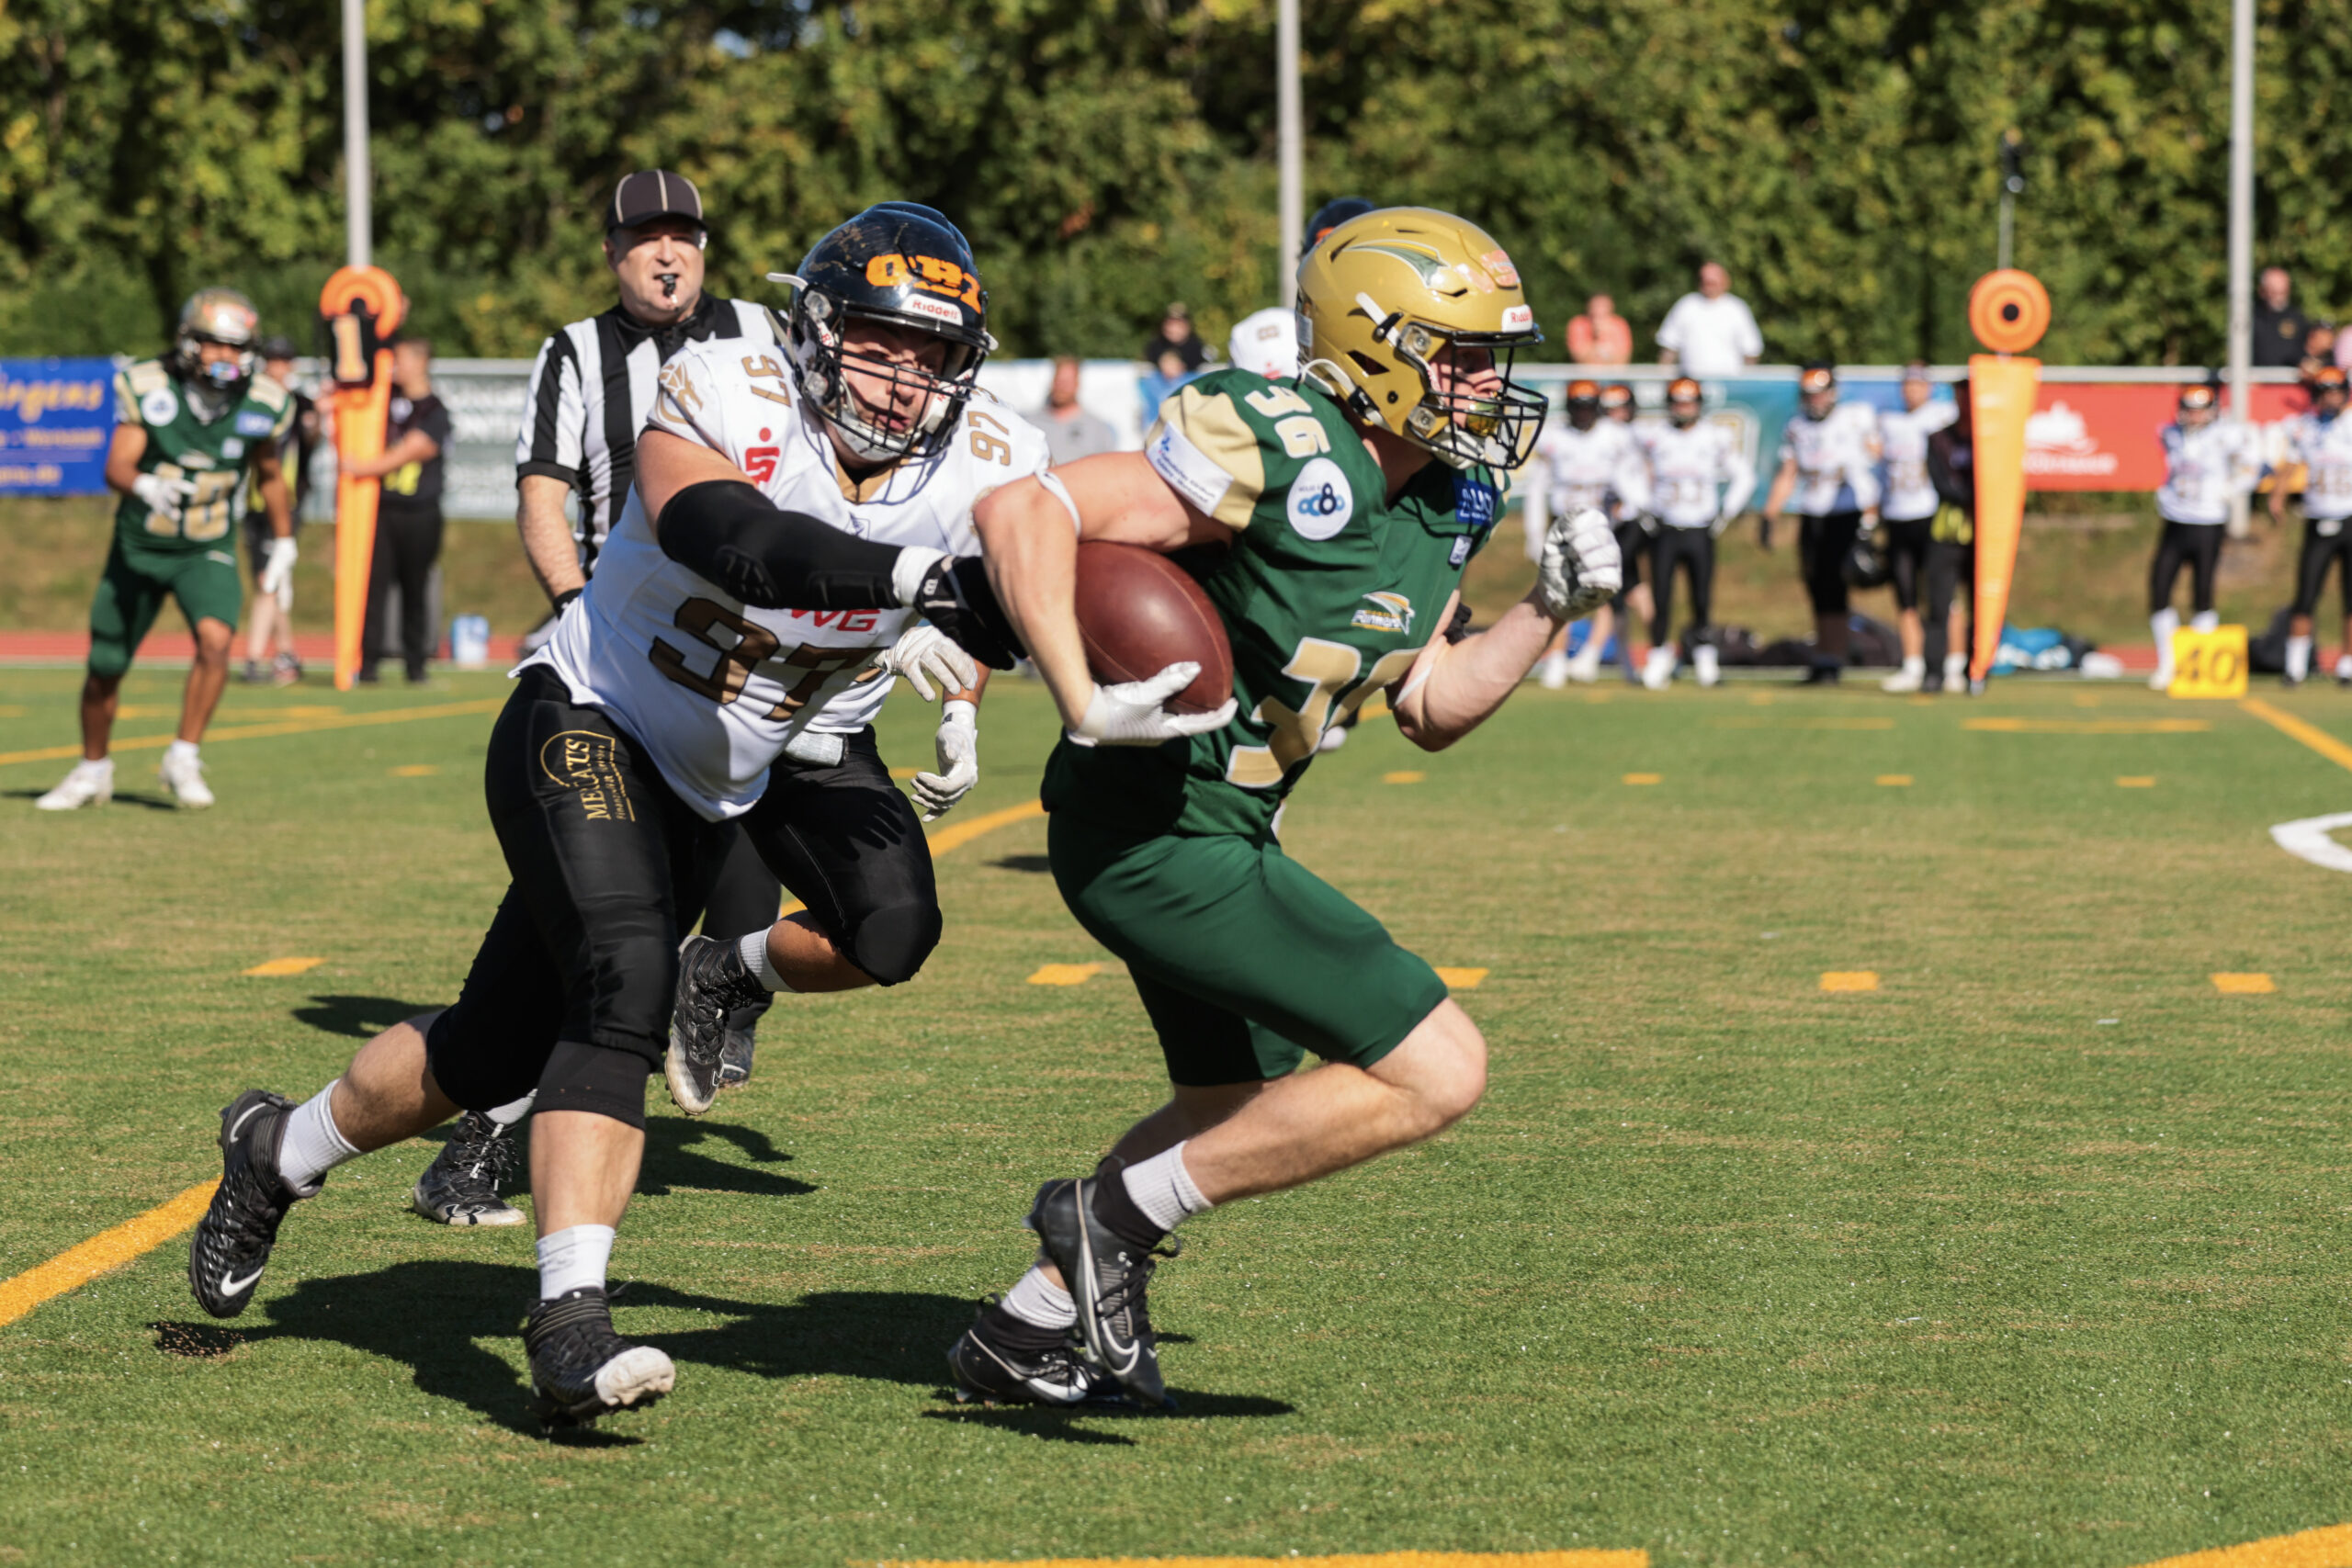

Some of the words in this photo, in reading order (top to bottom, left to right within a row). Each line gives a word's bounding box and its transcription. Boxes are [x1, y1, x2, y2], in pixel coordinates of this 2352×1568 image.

[912, 299, 958, 320] Riddell
[332, 313, 368, 382] 1
[741, 355, 792, 407] 97
[967, 411, 1011, 467] 97
[1244, 386, 1331, 458] 36
[649, 596, 889, 722] 97
[2175, 646, 2240, 685] 40
